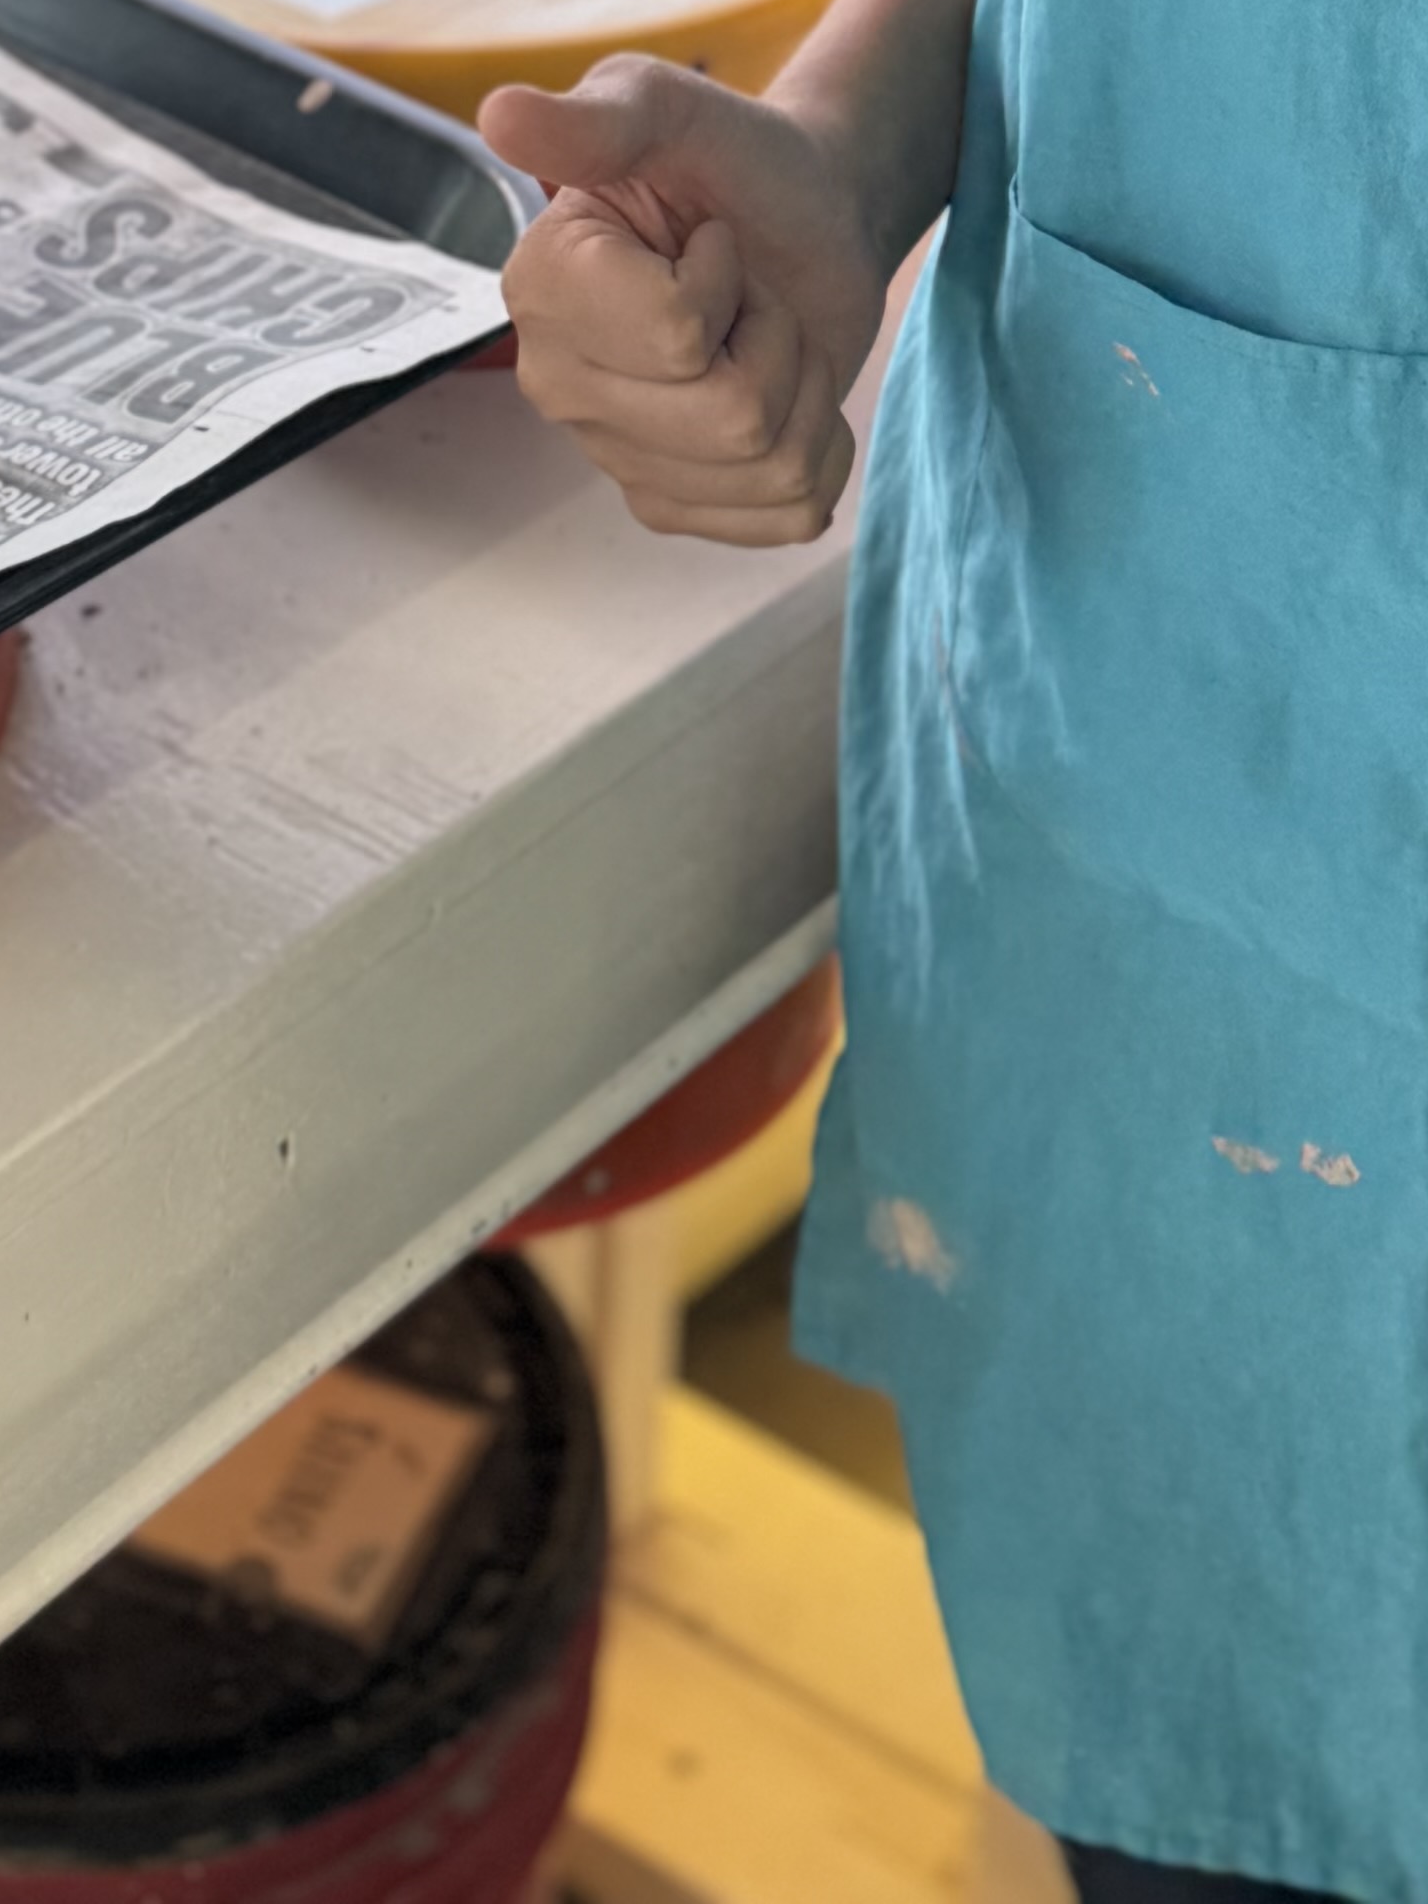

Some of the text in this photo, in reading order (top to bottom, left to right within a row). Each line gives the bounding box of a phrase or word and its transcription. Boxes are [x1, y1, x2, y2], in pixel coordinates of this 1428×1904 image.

[34, 196, 412, 347] CHIPS
[38, 417, 100, 447] the
[84, 435, 148, 462] all
